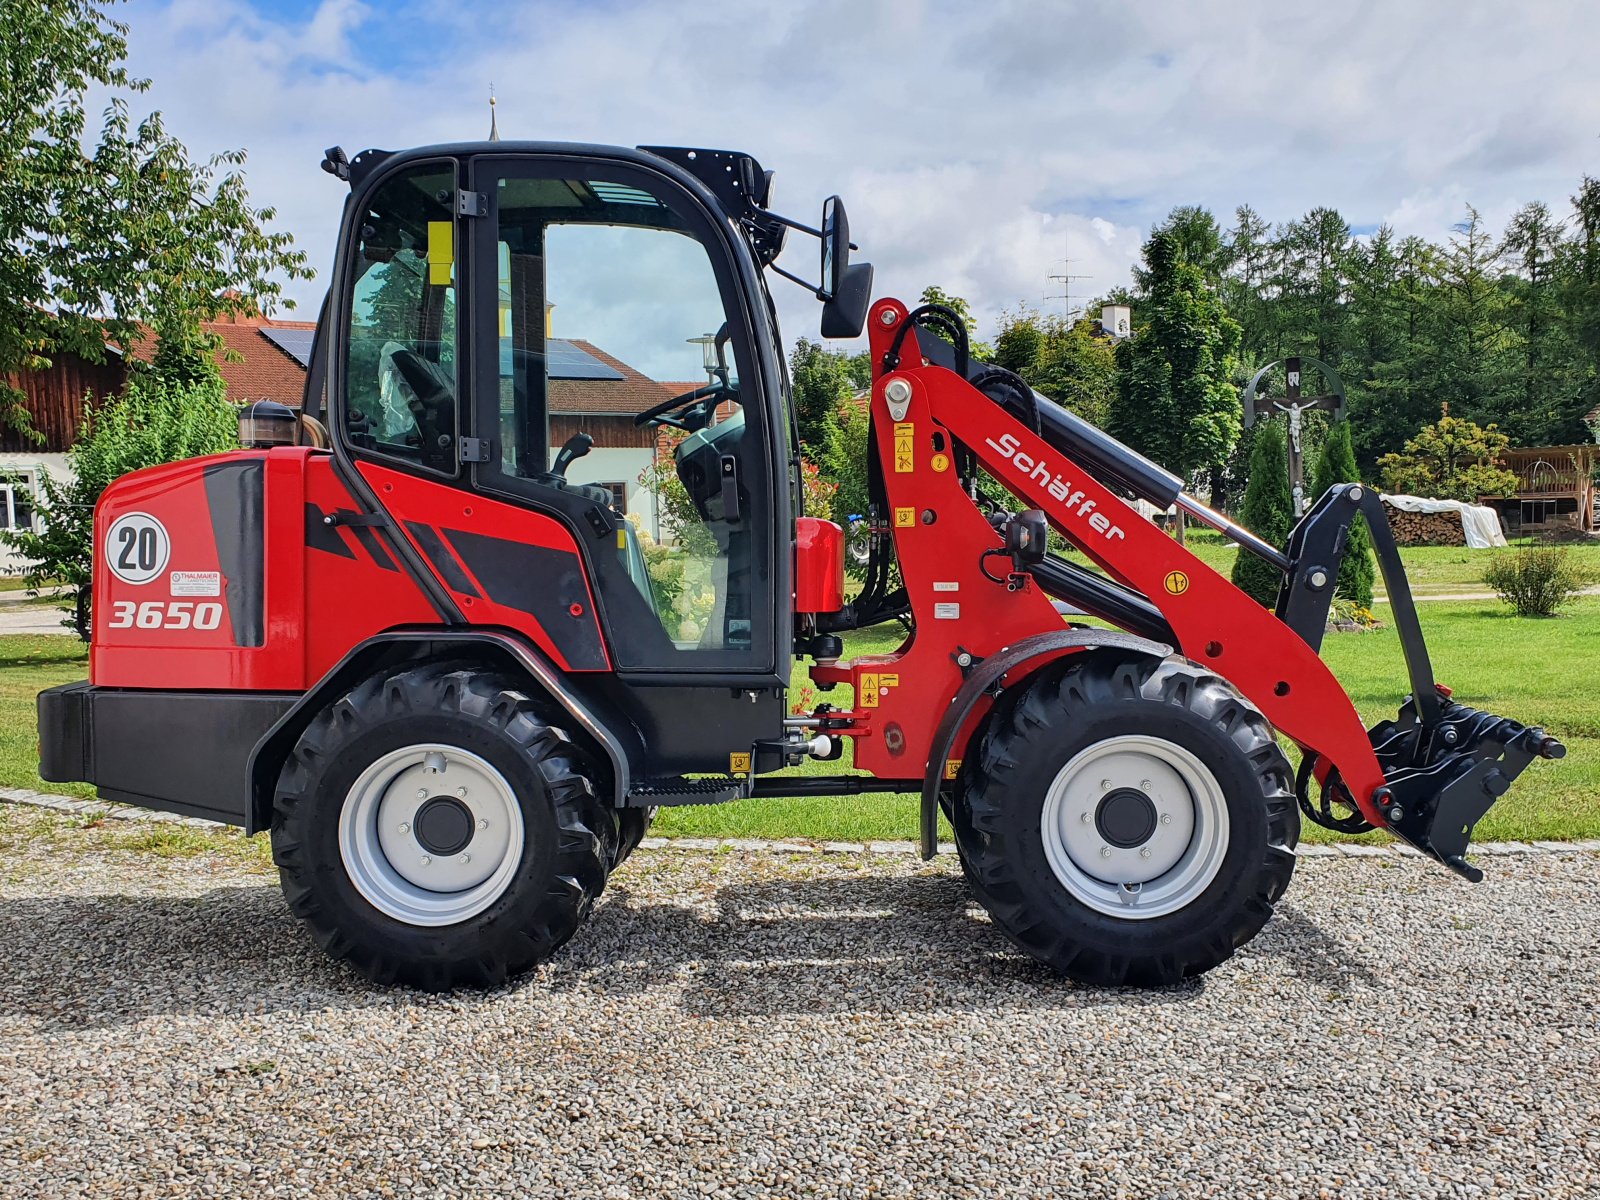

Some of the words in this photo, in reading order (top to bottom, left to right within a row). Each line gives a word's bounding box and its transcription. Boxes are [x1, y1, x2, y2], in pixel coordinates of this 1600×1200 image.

[985, 433, 1125, 540] Schäffer
[118, 526, 157, 571] 20
[108, 601, 223, 630] 3650
